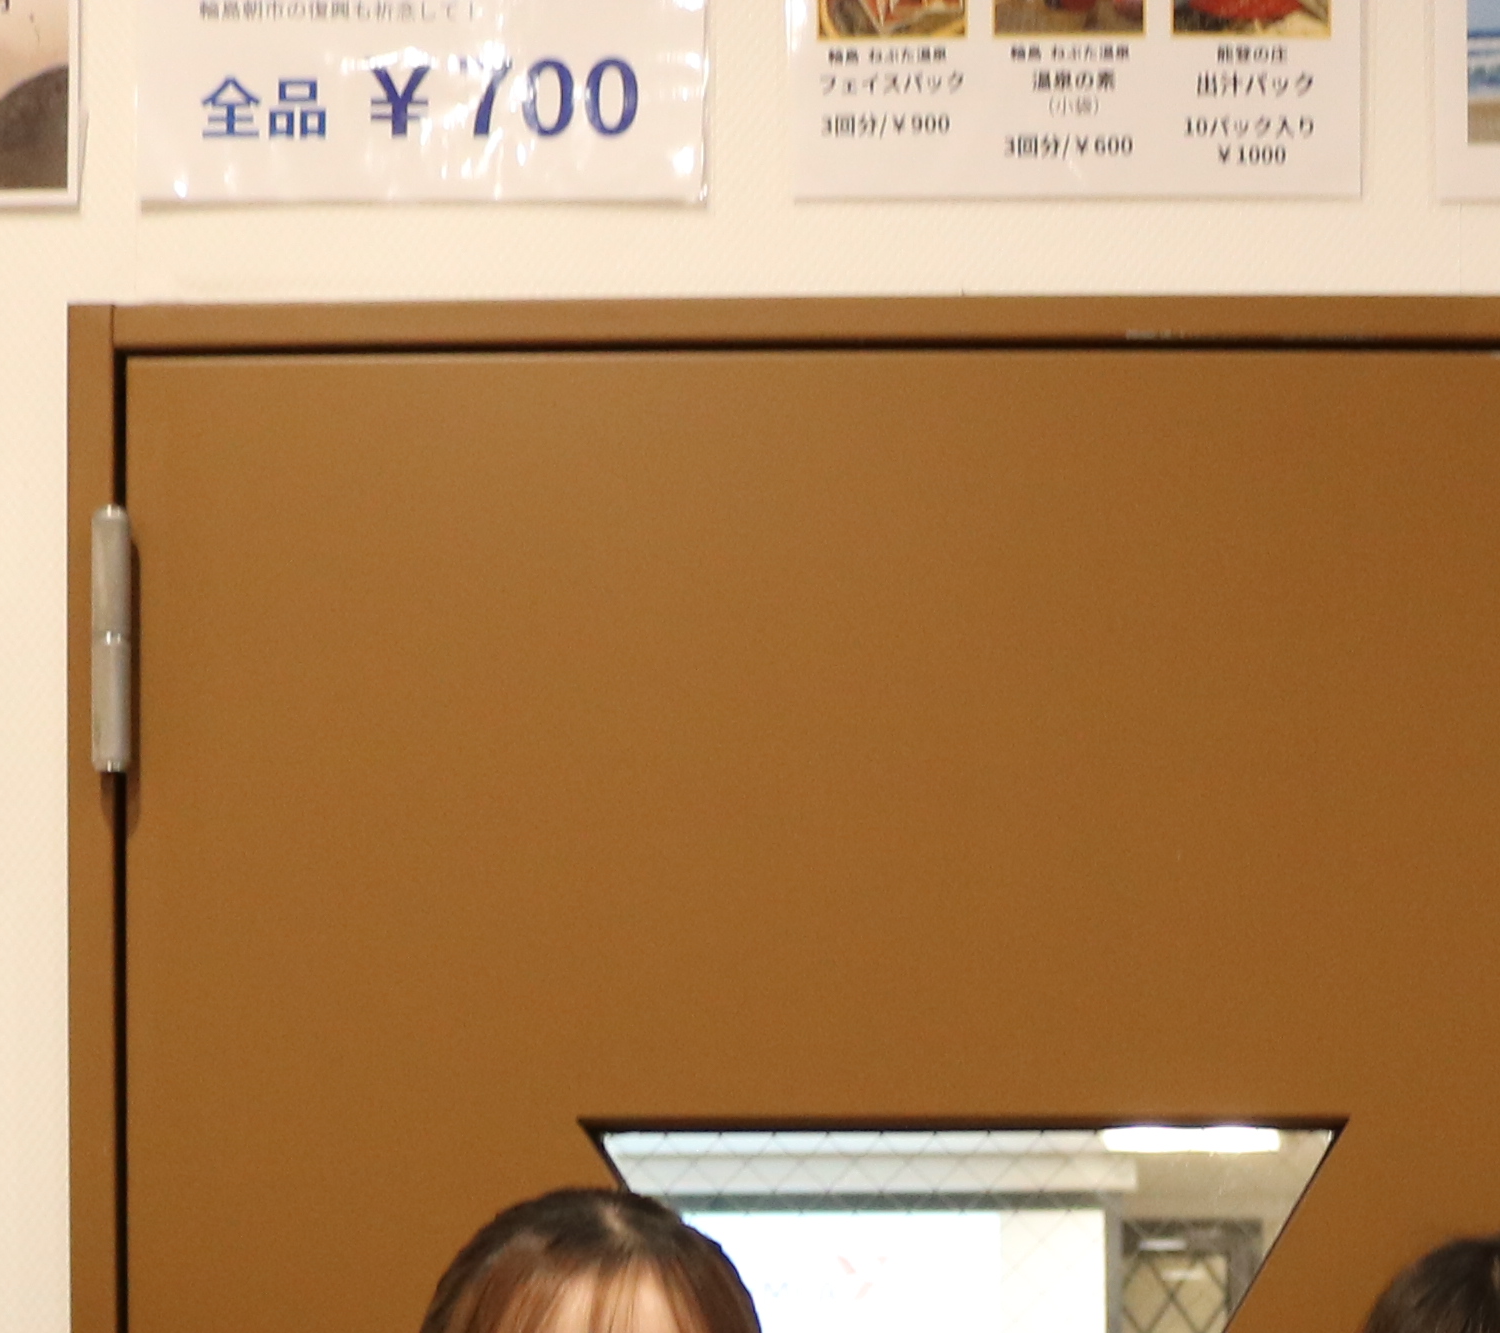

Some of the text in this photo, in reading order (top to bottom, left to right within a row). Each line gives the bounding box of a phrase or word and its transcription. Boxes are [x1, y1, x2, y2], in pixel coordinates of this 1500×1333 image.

[819, 72, 966, 97] フェイスパック
[1032, 69, 1117, 93] 温泉の素
[1196, 72, 1316, 98] 出汁パック
[200, 76, 328, 140] 全品
